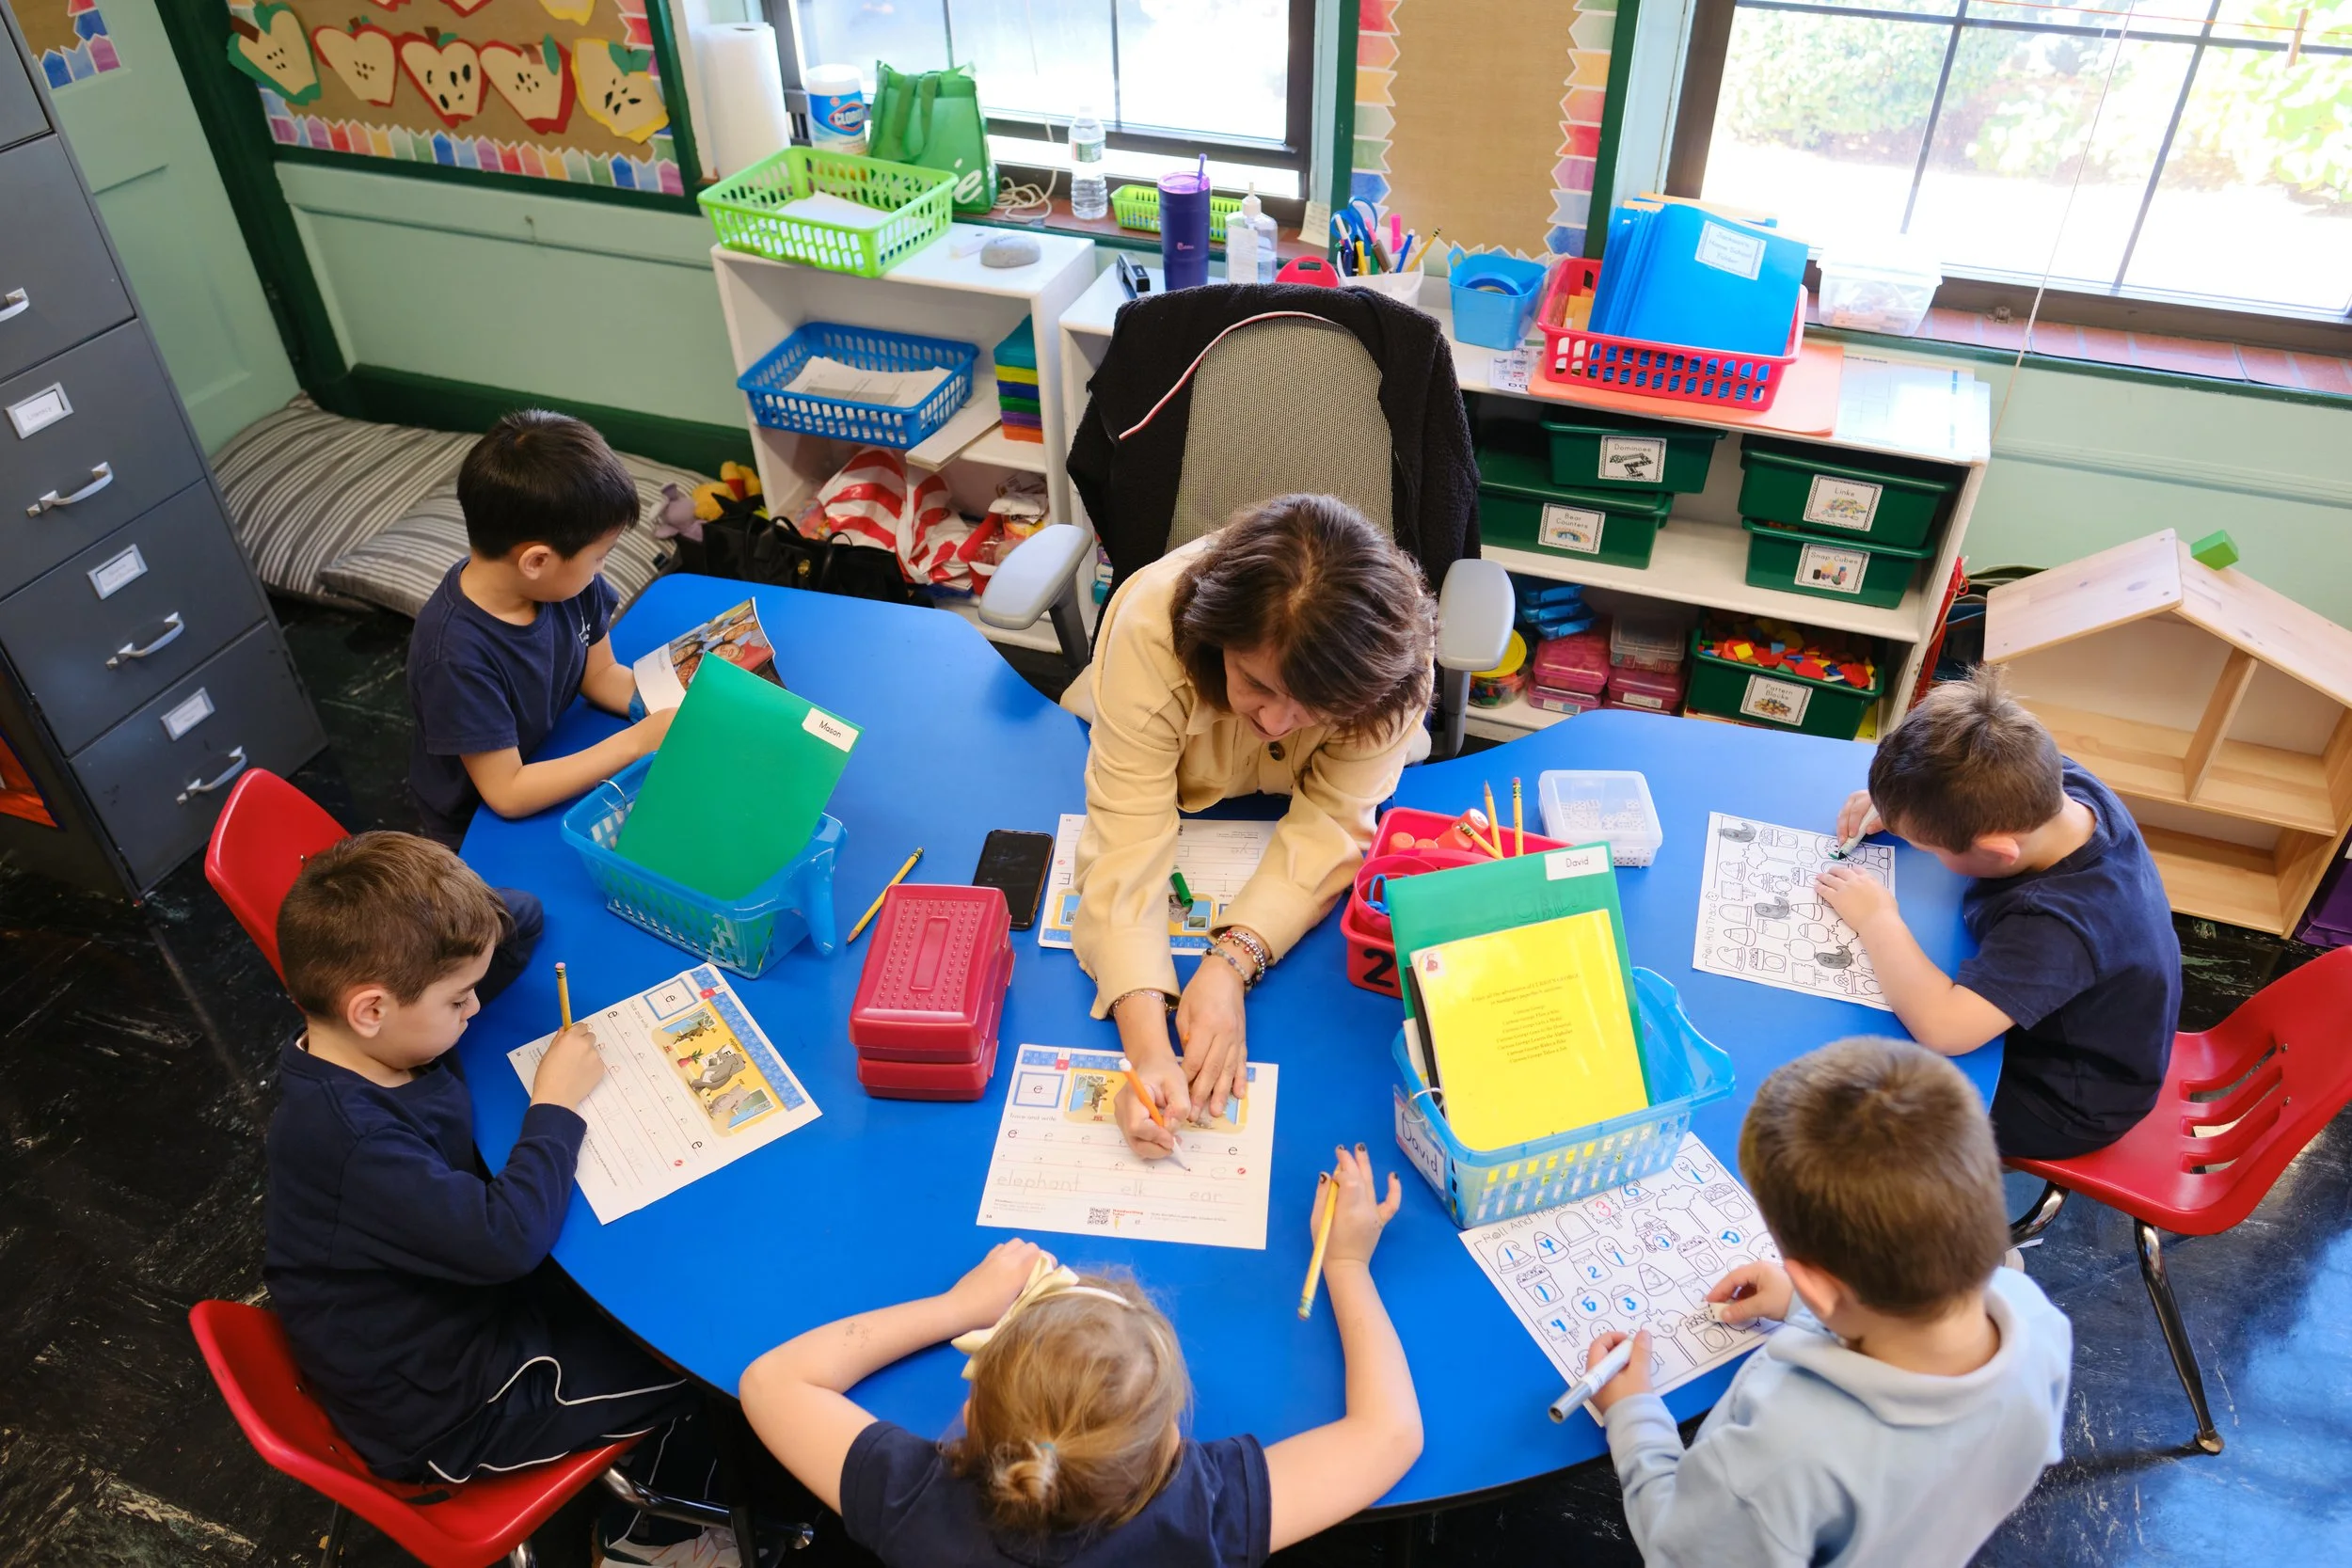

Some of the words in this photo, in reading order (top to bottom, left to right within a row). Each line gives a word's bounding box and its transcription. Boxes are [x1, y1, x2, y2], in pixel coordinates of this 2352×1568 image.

[1614, 443, 1652, 452] Dominoes
[1835, 487, 1855, 497] Links
[1556, 517, 1588, 529] Counters
[1565, 513, 1581, 521] Bear
[1810, 551, 1831, 561] Snap
[1834, 555, 1858, 564] Cubes
[1766, 684, 1793, 695] Pattern
[1766, 690, 1789, 700] Blocks
[818, 720, 842, 738] Mason
[1565, 856, 1589, 867] David
[1362, 947, 1394, 989] 2
[665, 994, 675, 1003] e
[607, 1010, 618, 1019] e
[691, 1140, 703, 1150] e
[1033, 1085, 1043, 1094] e
[1008, 1130, 1018, 1139] e
[1228, 1147, 1238, 1156] e
[1402, 1111, 1438, 1176] David
[997, 1169, 1080, 1195] elephant
[1120, 1180, 1145, 1197] elk
[1190, 1191, 1222, 1203] ear
[1595, 1200, 1613, 1218] 3
[1481, 1227, 1509, 1244] Roll
[1510, 1217, 1534, 1230] And
[1538, 1238, 1557, 1255] 4
[1587, 1265, 1602, 1279] 2
